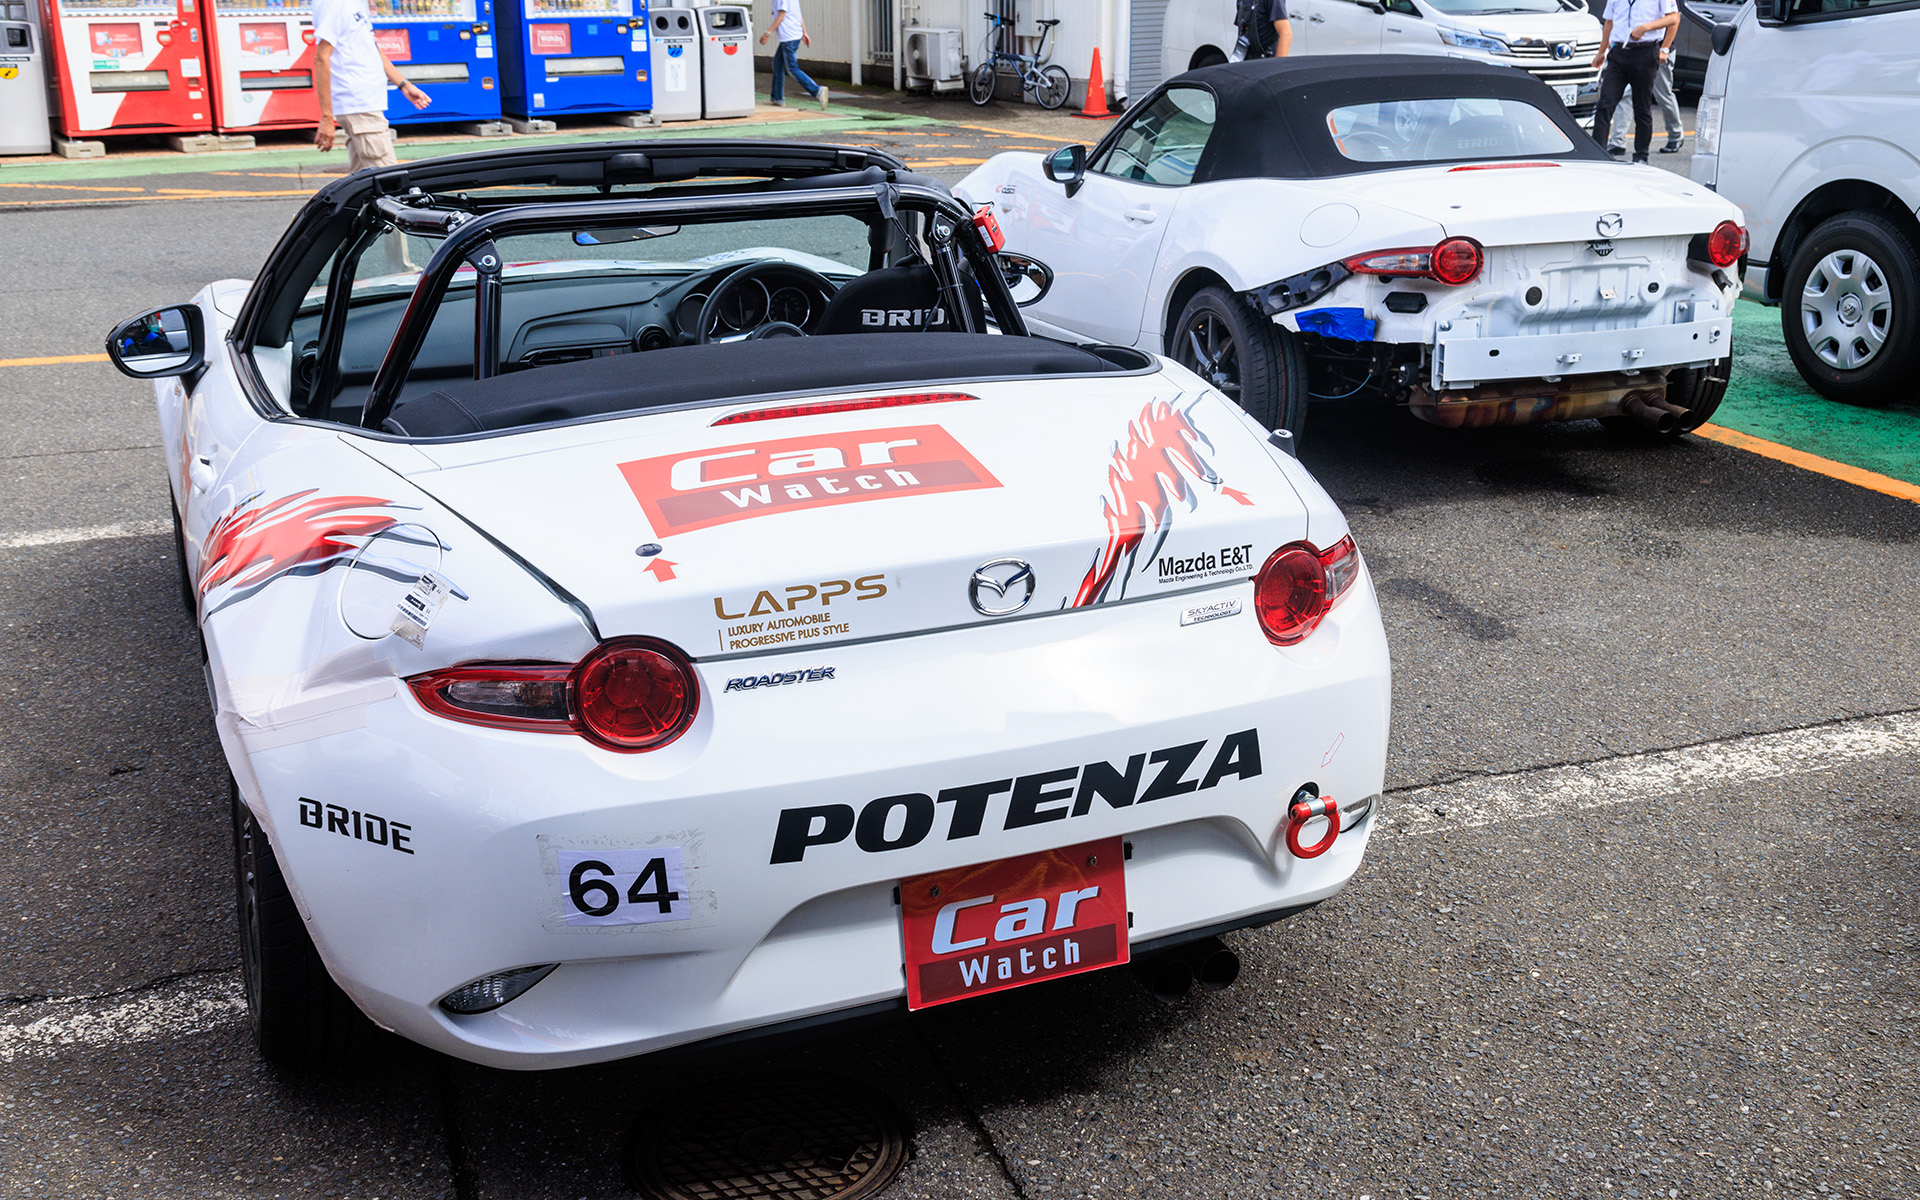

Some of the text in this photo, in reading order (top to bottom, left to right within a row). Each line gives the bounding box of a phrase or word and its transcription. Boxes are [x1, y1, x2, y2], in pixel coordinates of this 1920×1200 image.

[860, 308, 950, 326] BRID
[670, 438, 921, 492] Car
[719, 468, 922, 508] Watch
[1158, 544, 1253, 577] Mazda E&T
[1158, 576, 1175, 584] Mazda
[1175, 573, 1203, 582] Engineering
[1208, 567, 1234, 576] Technology
[713, 573, 888, 621] LAPPS
[1188, 600, 1236, 616] SKYACTIV
[1193, 609, 1232, 621] TECHNOLOGY
[727, 612, 832, 638] LUXURY AUTOMOBILE
[729, 622, 850, 651] PROGRESSIVE PLUS STYLE
[723, 664, 838, 693] ROADSTER
[769, 727, 1263, 865] POTENZA
[297, 796, 415, 855] BRIDE
[567, 856, 680, 918] 64
[931, 886, 1100, 955] Car
[958, 938, 1080, 988] Watch
